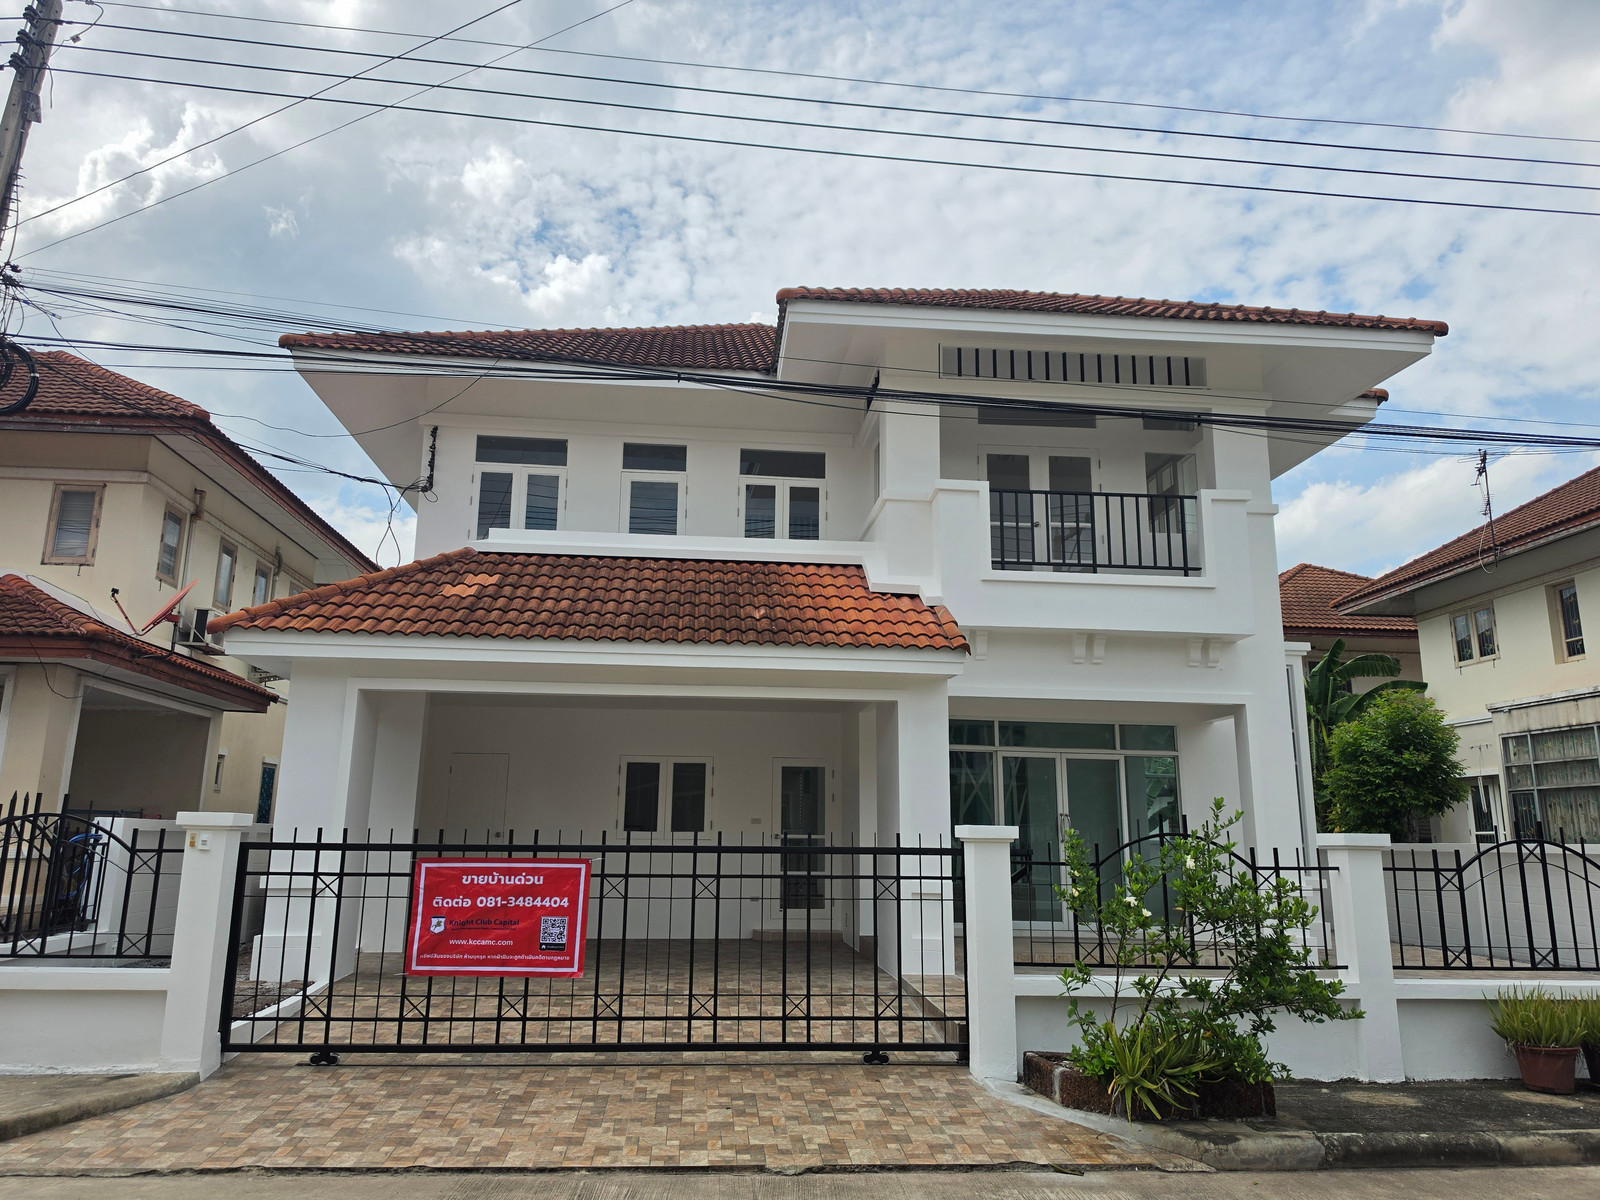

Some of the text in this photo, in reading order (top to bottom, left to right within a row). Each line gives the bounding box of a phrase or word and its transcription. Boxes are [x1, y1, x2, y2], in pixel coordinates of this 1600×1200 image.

[462, 872, 544, 885] ขายบ้านด่วน
[432, 895, 569, 908] ติดต่อ 081-3484404
[475, 918, 492, 926] Club
[493, 919, 520, 927] Capital
[449, 938, 513, 946] www.kccamc.com
